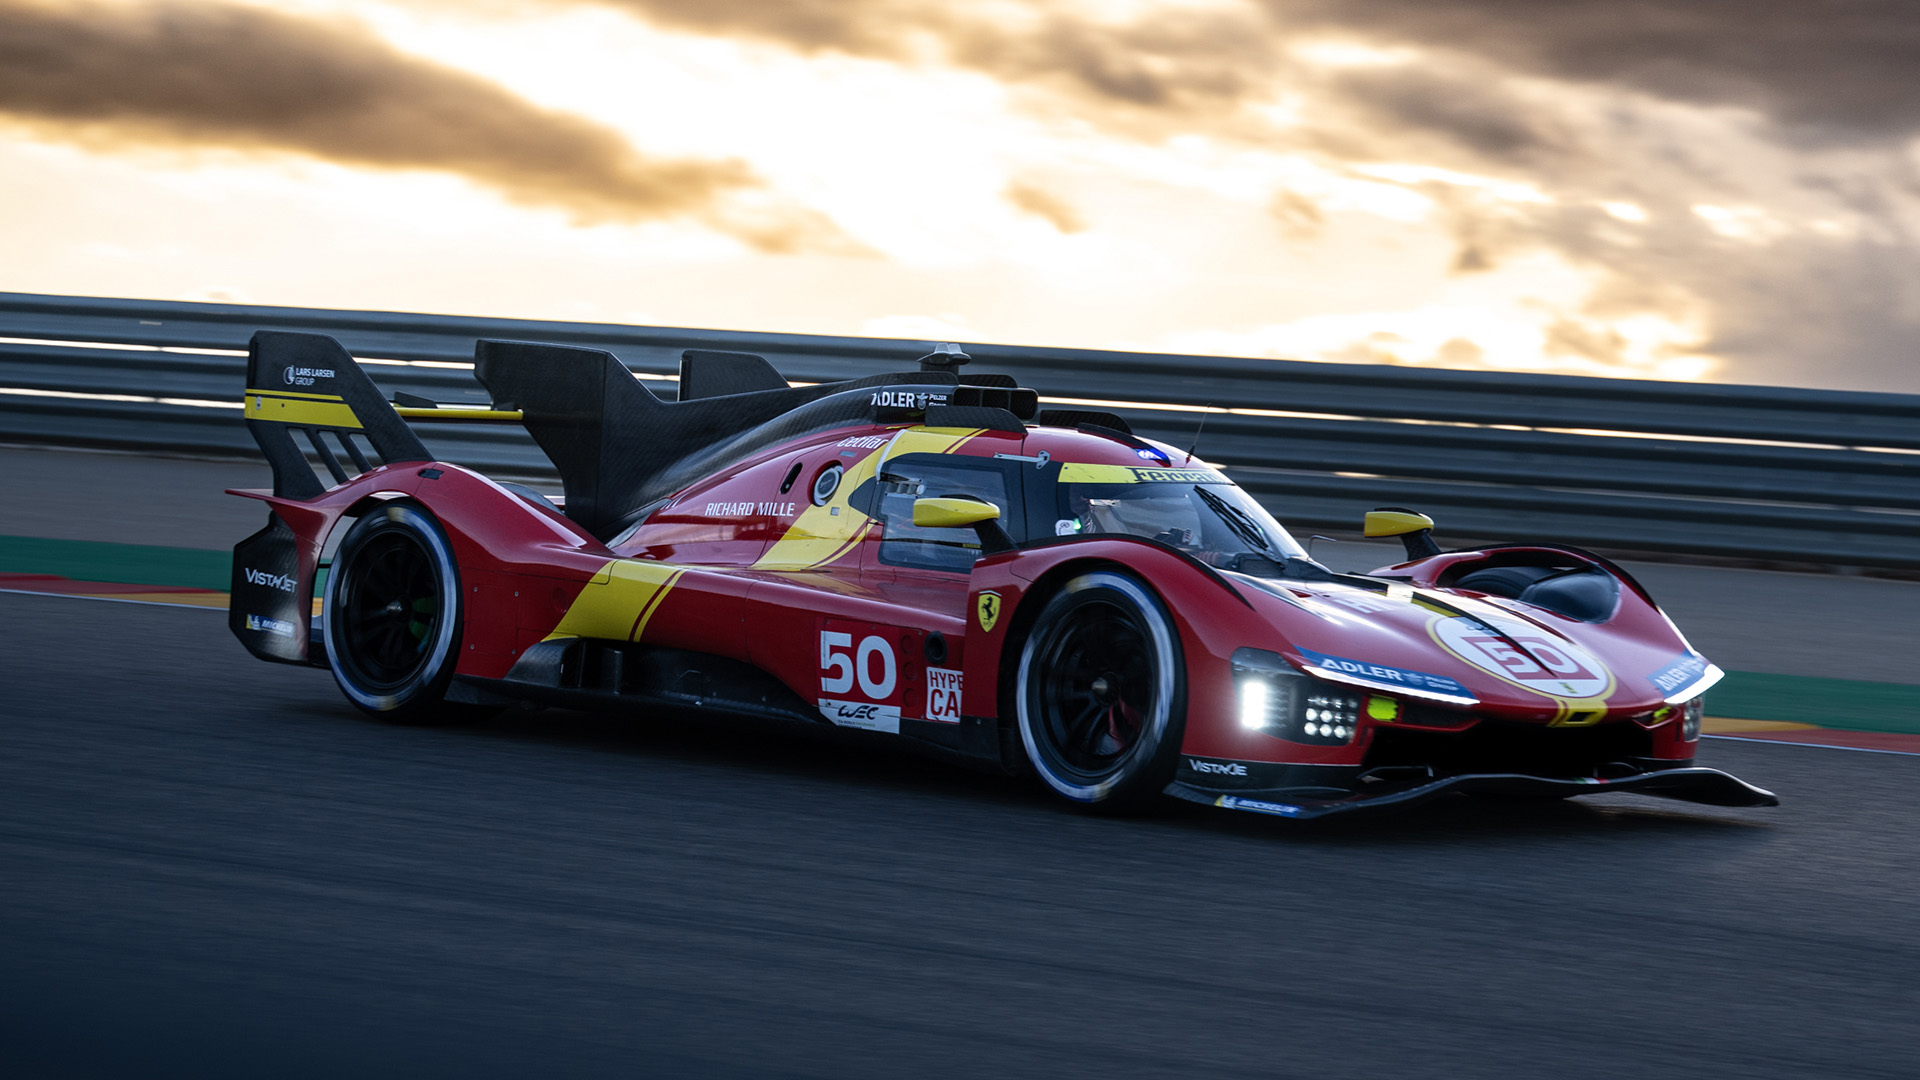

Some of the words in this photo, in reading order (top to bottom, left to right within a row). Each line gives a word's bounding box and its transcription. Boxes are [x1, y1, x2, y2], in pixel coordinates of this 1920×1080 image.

[296, 367, 311, 376] LARS
[312, 369, 335, 378] LARSEN
[295, 377, 315, 386] GROUP
[870, 391, 915, 408] ADLER
[704, 502, 755, 516] RICHARD
[756, 502, 796, 517] MILLE
[820, 630, 897, 700] 50
[1473, 641, 1580, 674] 50
[1321, 658, 1405, 682] ADLER
[837, 704, 880, 721] WEC
